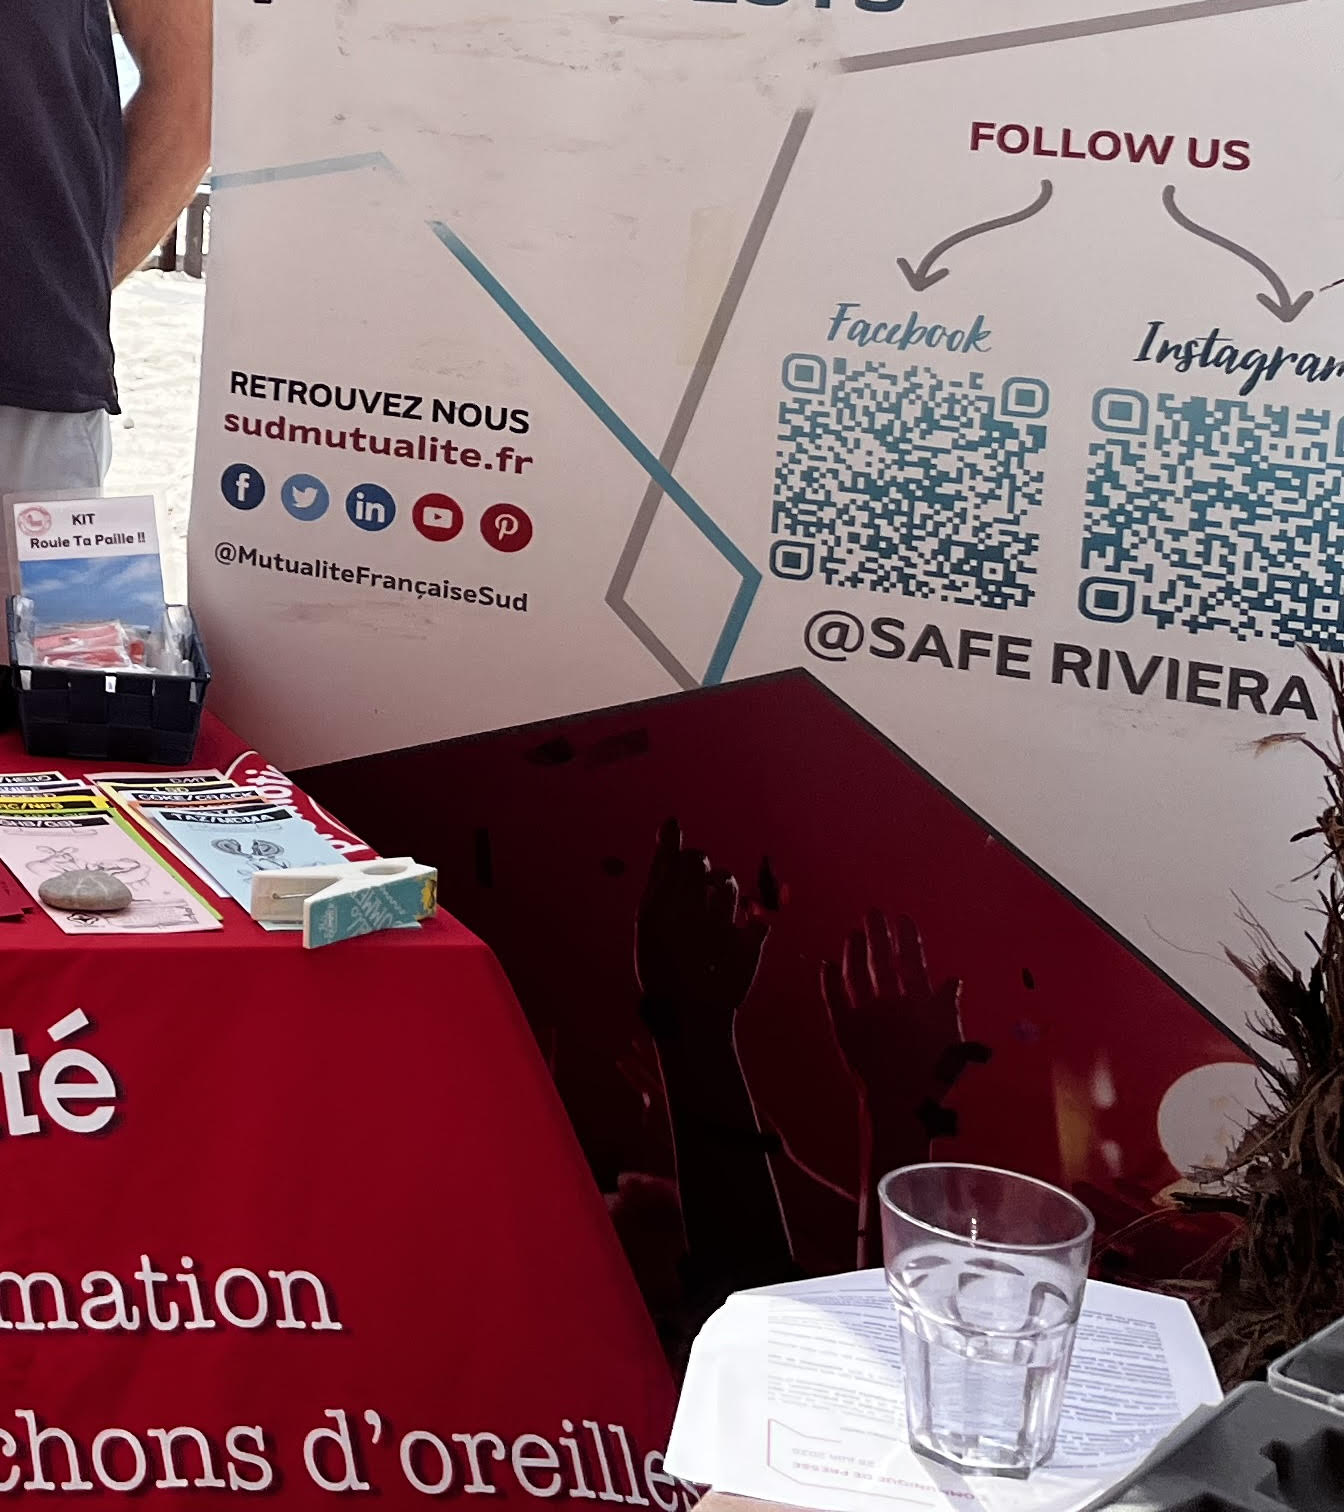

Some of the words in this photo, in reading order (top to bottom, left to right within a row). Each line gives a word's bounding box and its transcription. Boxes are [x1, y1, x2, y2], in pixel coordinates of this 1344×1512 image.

[969, 120, 1175, 170] FOLLOW
[1185, 134, 1253, 173] US
[827, 302, 994, 355] Facebook
[228, 369, 424, 424] RETROUVEZ
[431, 394, 531, 436] NOUS
[222, 409, 535, 478] sudmutualite.fr
[30, 536, 70, 550] Roule
[73, 535, 92, 548] Ta
[94, 531, 134, 546] Paille
[71, 512, 95, 526] KIT
[213, 540, 530, 614] @MutualiteFrançaiseSud
[804, 608, 1035, 682] @SAFE
[1052, 641, 1321, 722] RIVIERA
[139, 790, 253, 801] COKE/CRACK
